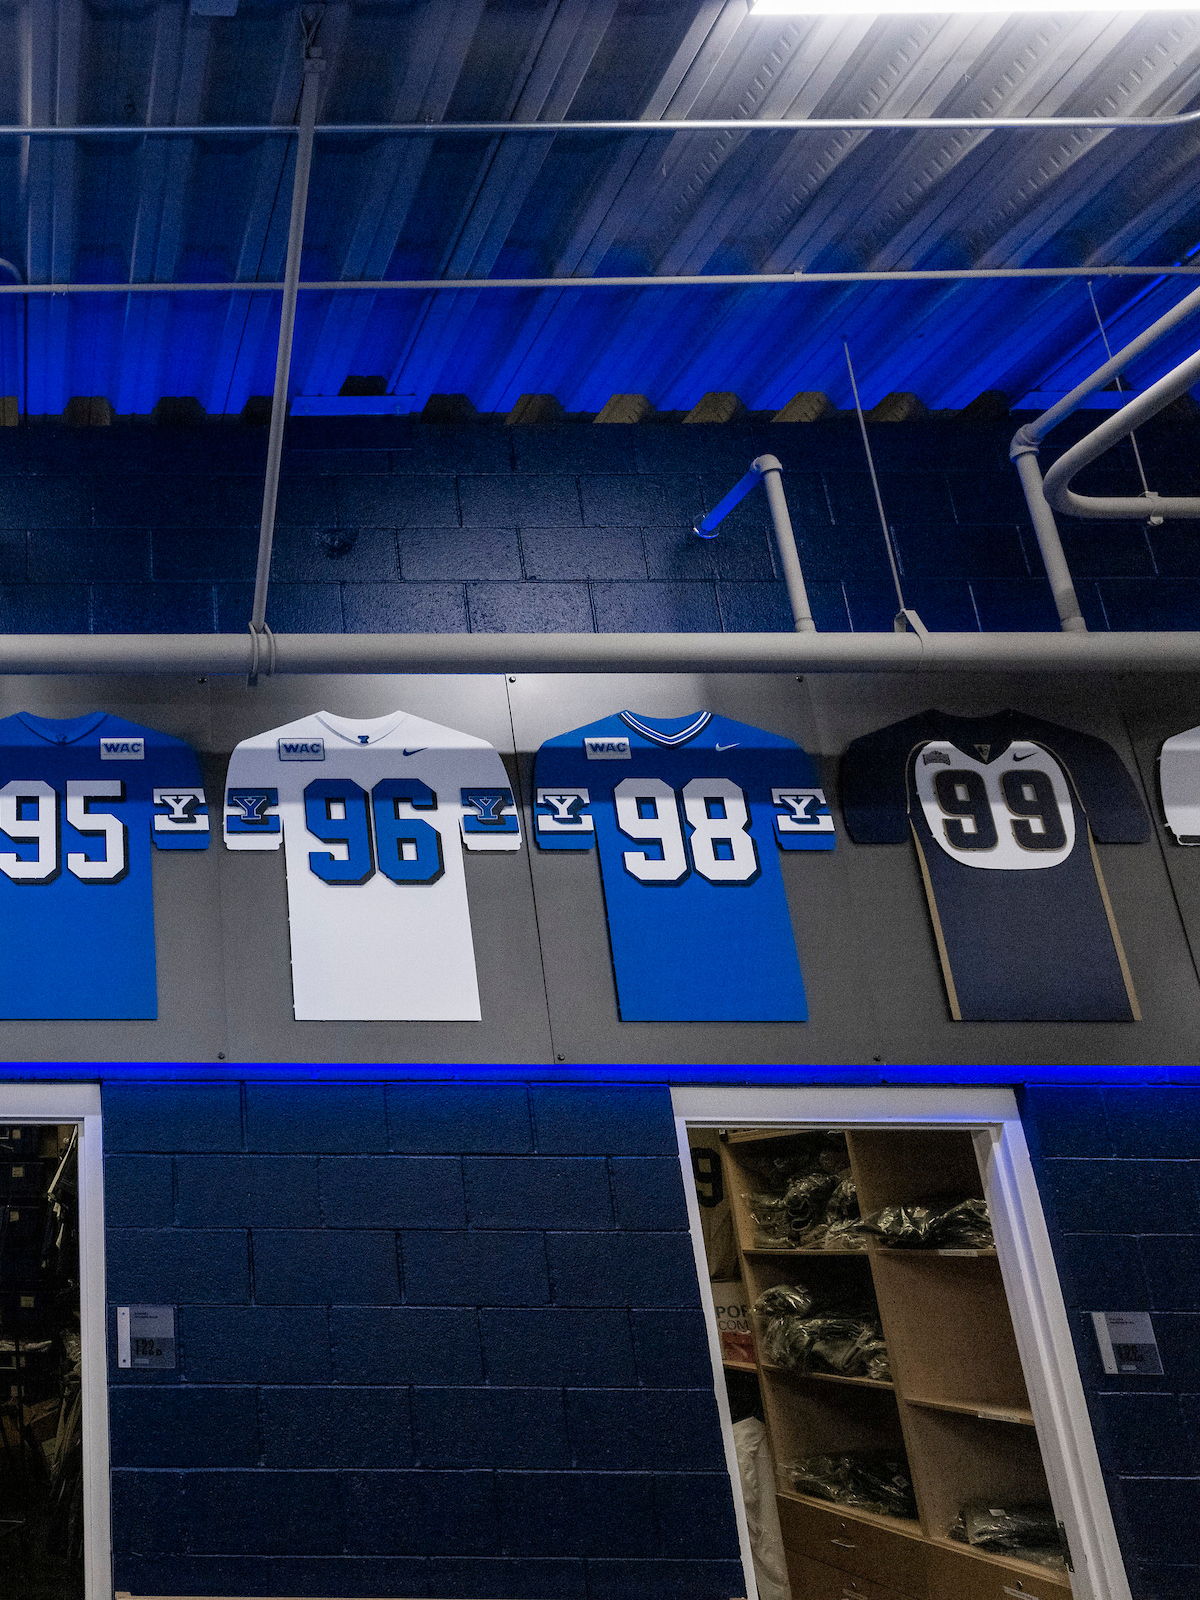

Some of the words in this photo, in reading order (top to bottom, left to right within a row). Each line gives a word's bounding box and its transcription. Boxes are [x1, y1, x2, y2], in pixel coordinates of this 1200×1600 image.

[103, 743, 142, 753] WAC
[283, 743, 321, 753] WAC
[589, 743, 627, 753] WAC
[161, 795, 199, 822] Y
[232, 795, 269, 822] Y
[468, 795, 507, 822] Y
[544, 794, 579, 820] Y
[782, 795, 820, 821] Y
[934, 769, 1068, 852] 99
[0, 779, 129, 885] 95
[305, 778, 445, 886] 96
[614, 777, 761, 886] 98
[691, 1147, 722, 1207] 9
